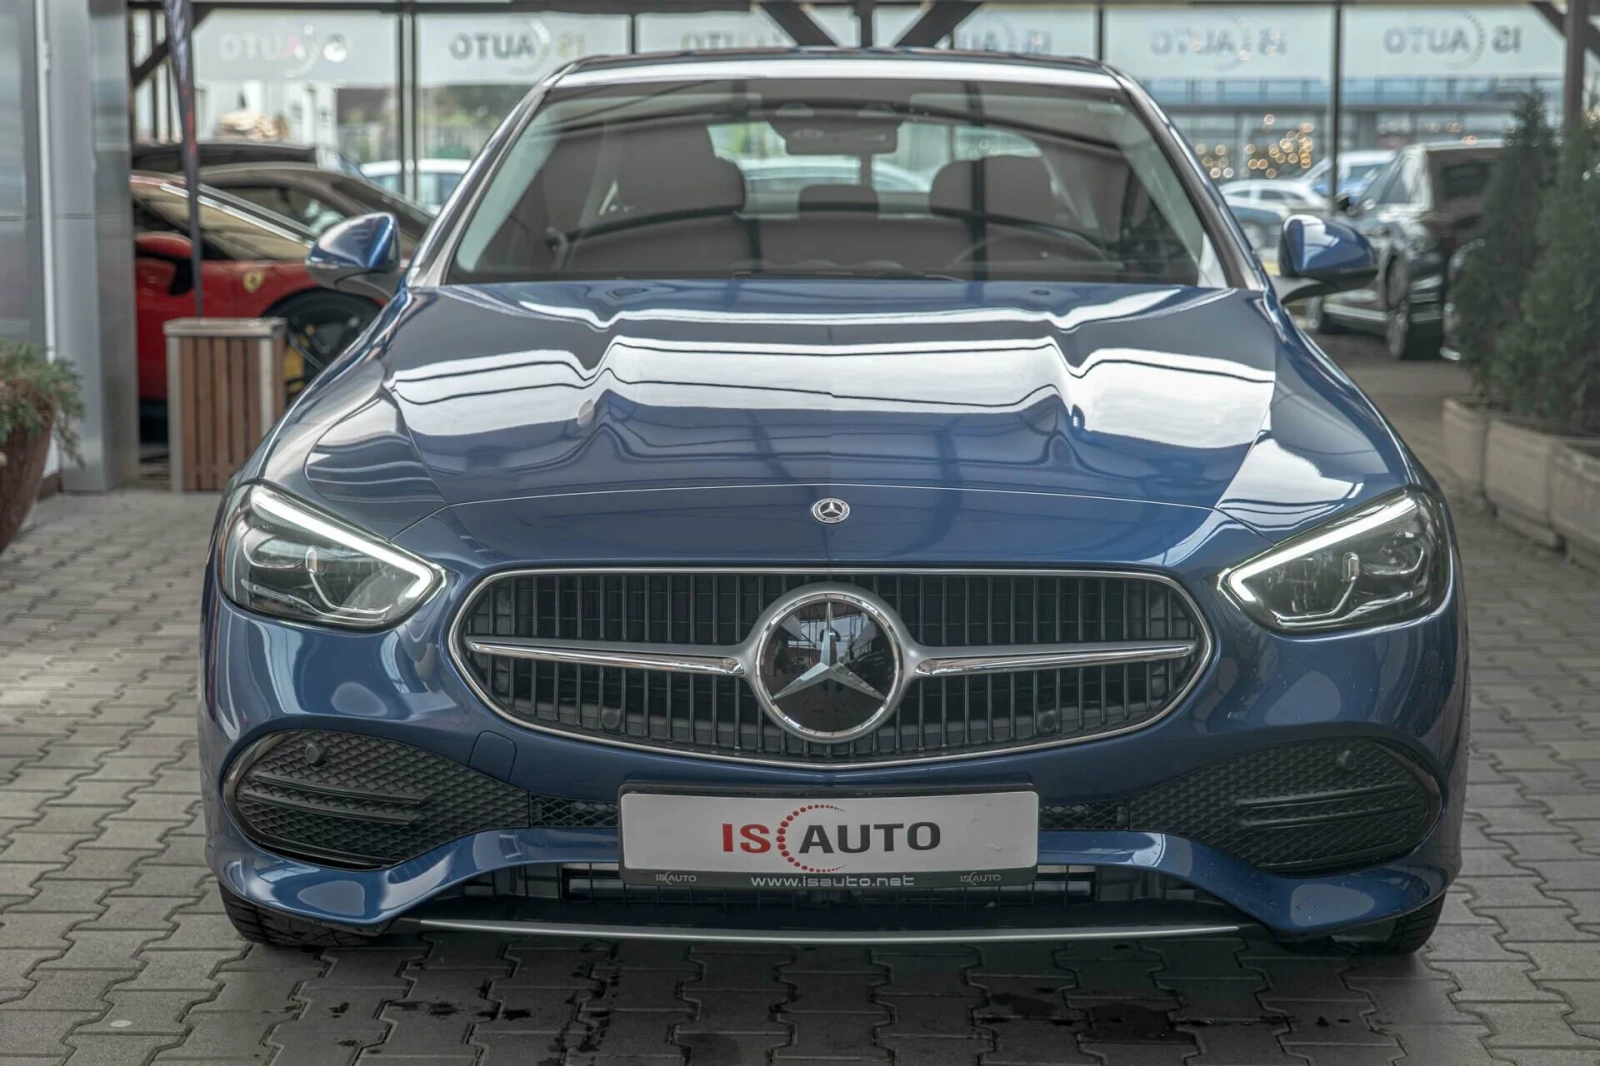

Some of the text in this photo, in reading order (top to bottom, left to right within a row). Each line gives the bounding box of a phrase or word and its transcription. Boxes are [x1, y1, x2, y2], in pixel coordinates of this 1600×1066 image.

[721, 821, 941, 855] IS AUTO
[750, 875, 915, 888] www.isauto.net
